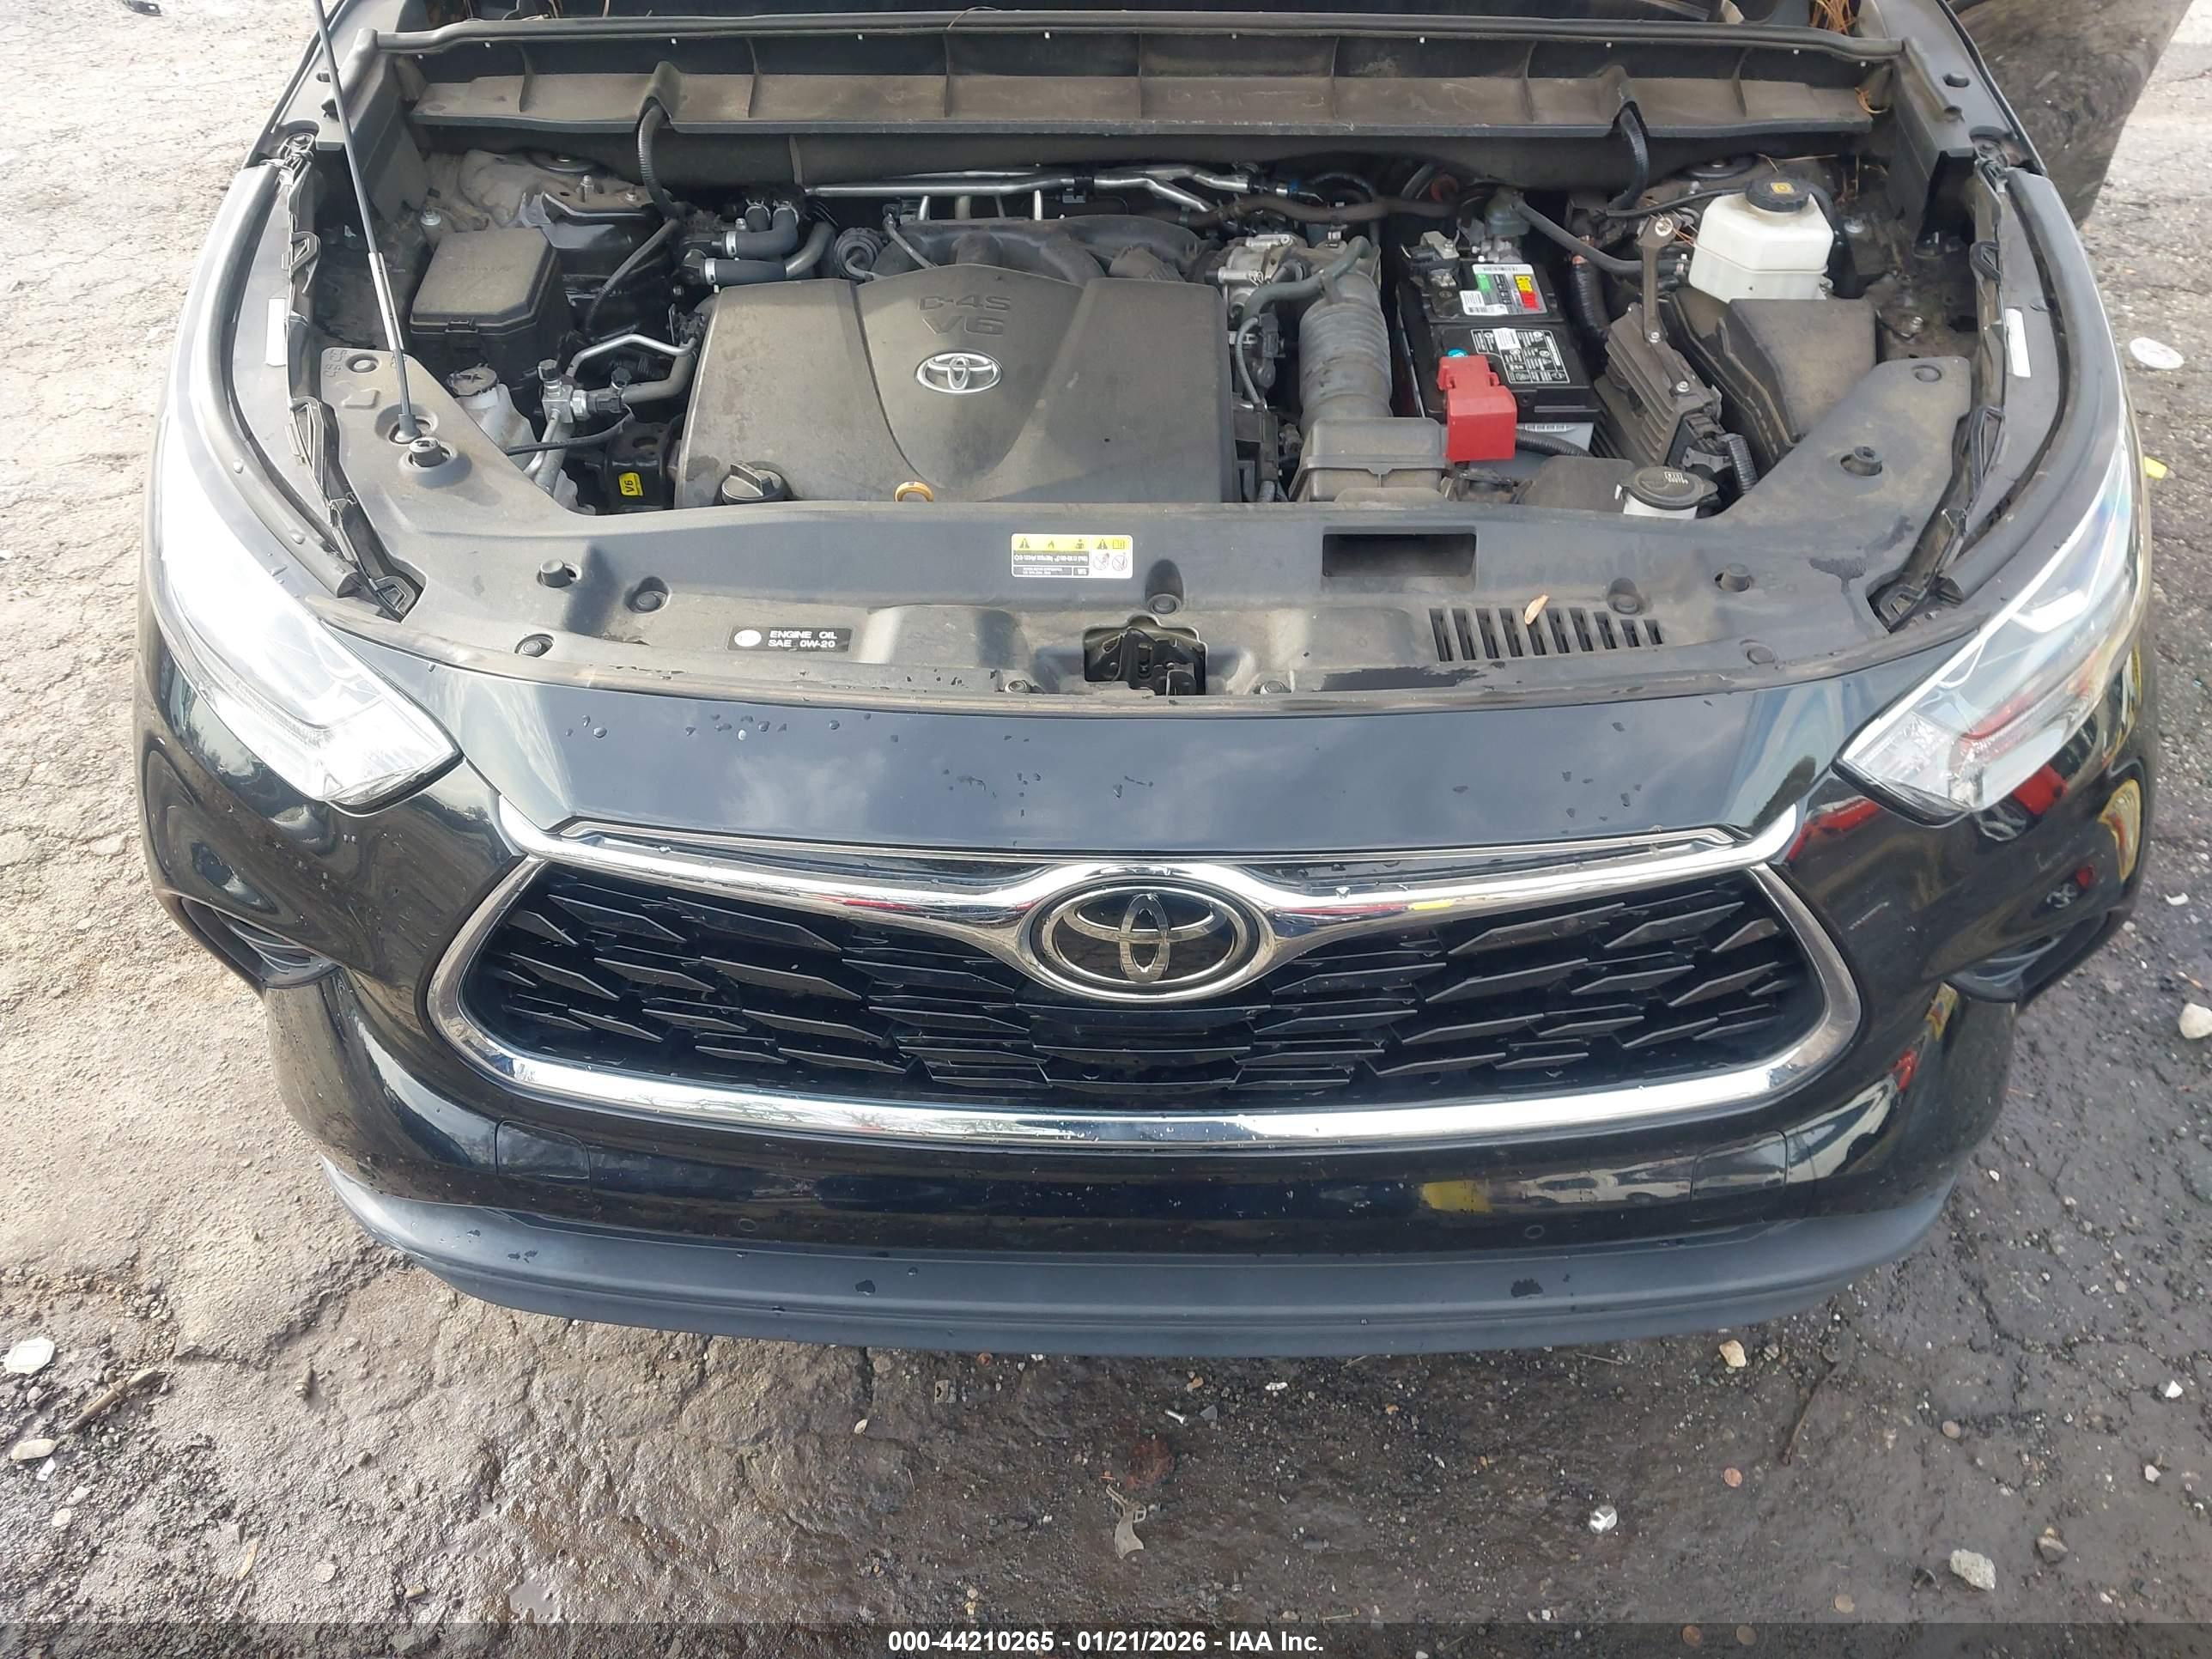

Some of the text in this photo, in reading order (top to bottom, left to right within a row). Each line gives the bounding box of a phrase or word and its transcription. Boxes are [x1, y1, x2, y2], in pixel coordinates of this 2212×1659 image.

[919, 295, 1011, 312] D-4S
[922, 315, 1004, 337] V6
[624, 480, 635, 493] V6
[769, 630, 838, 640] ENGINE OIL
[799, 640, 836, 648] 0W-20
